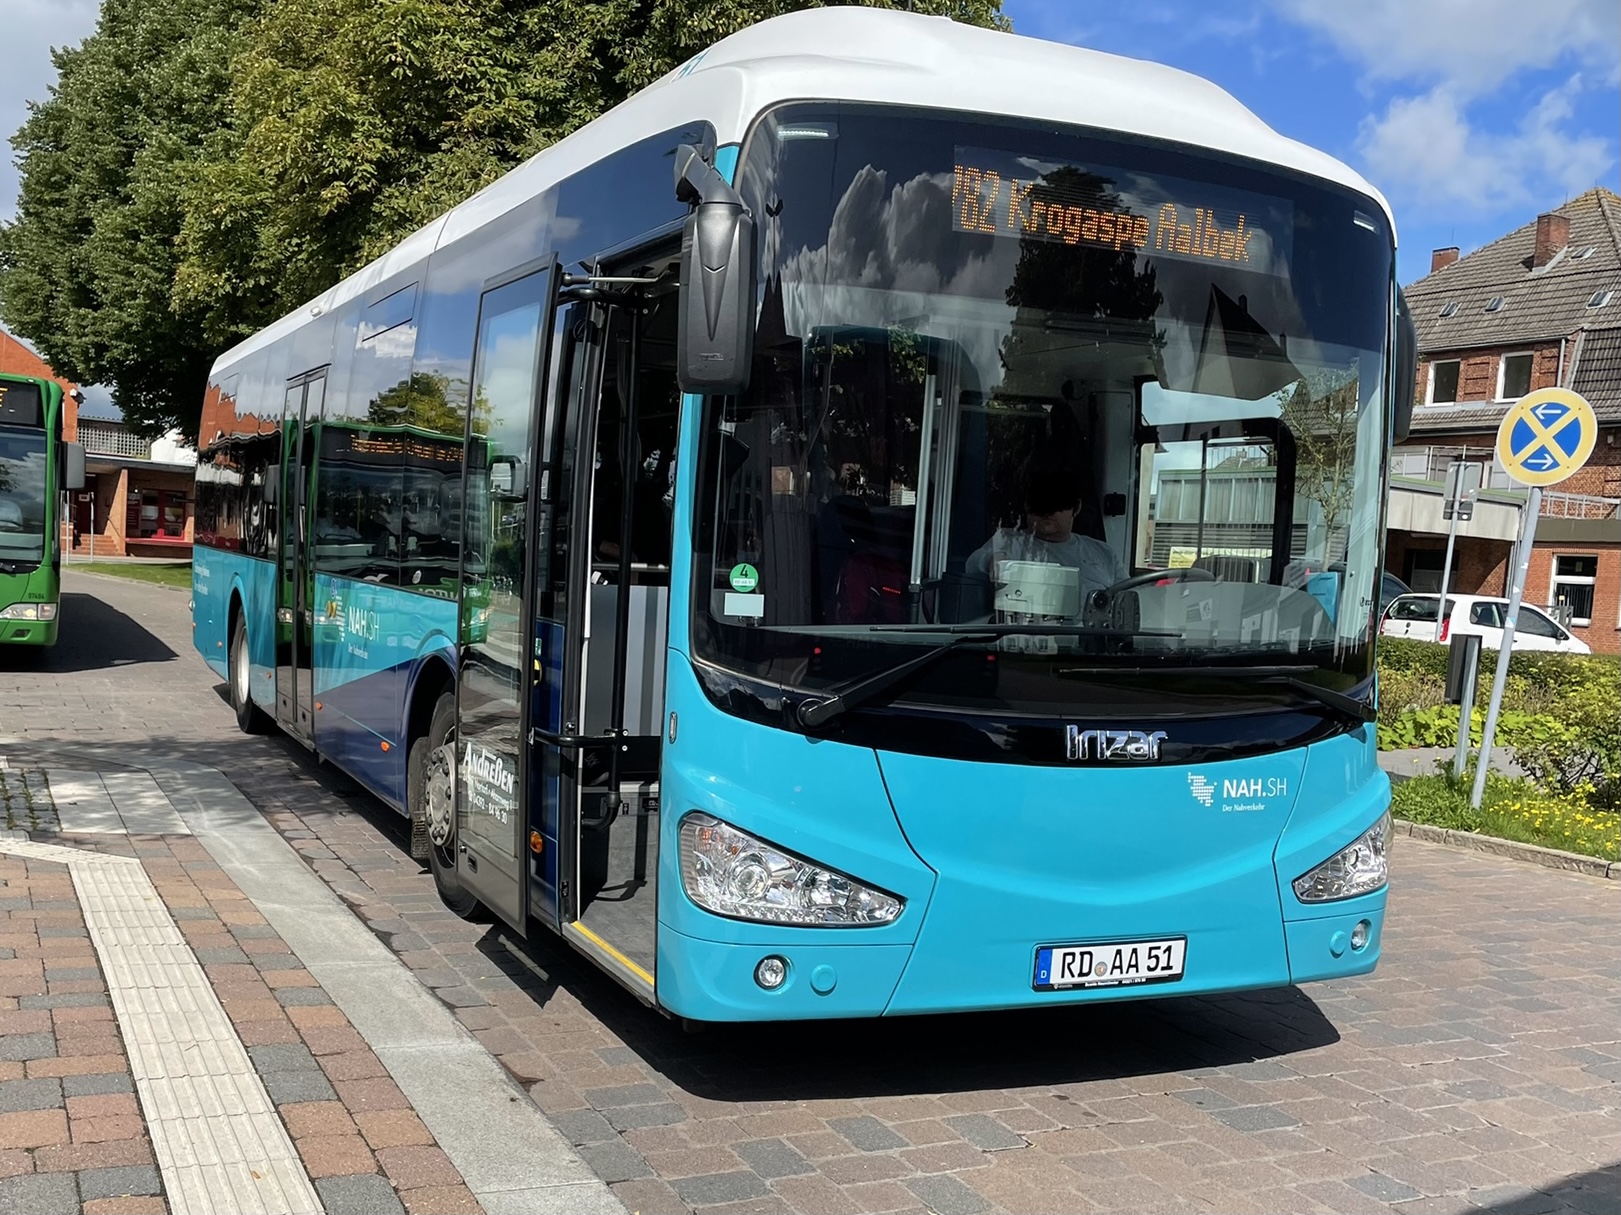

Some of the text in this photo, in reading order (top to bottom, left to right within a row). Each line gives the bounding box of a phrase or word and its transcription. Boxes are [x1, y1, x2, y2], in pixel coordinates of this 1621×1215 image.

[1007, 177, 1150, 250] Krogaspe
[1156, 202, 1252, 262] Aalbek
[740, 564, 748, 578] 4
[1223, 777, 1287, 799] NAH.SH
[1222, 803, 1233, 812] Der
[1061, 945, 1174, 979] RD AA 51
[1040, 970, 1047, 979] D
